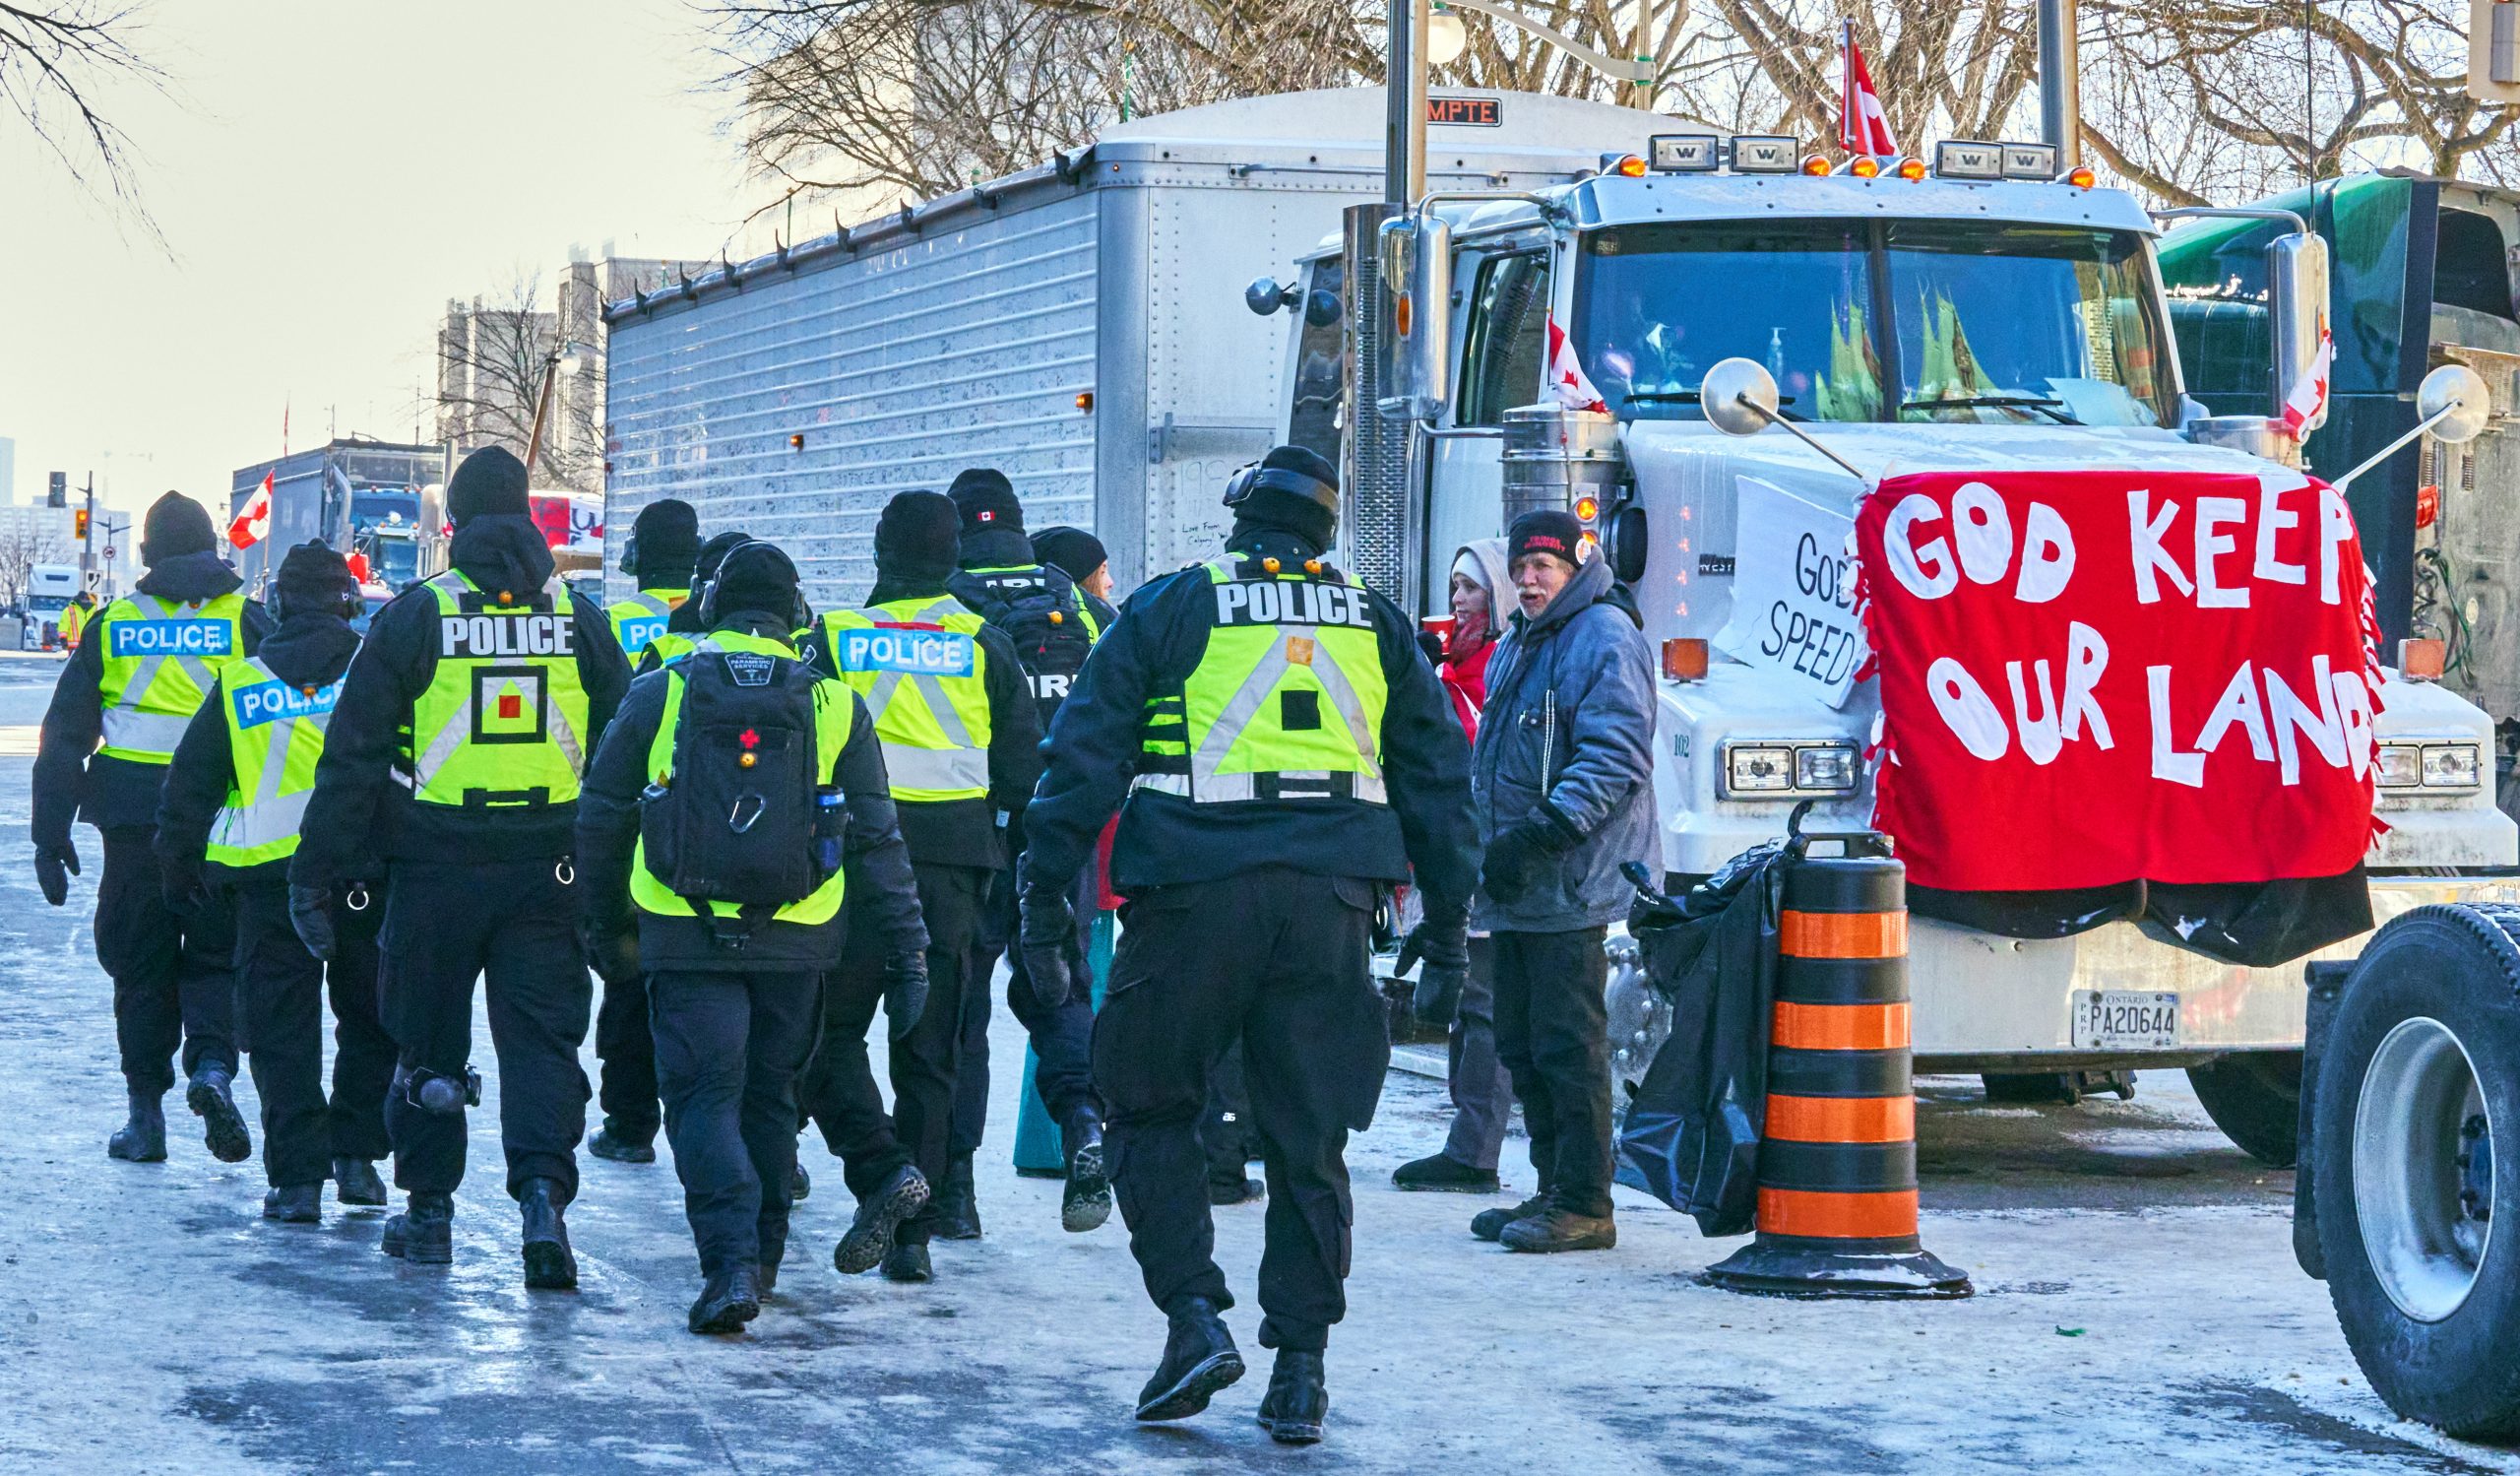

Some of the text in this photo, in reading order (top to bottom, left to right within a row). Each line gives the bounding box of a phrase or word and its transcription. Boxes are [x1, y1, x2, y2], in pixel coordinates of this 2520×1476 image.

[1427, 100, 1494, 123] MPTE
[1884, 475, 2354, 608] GOD KEEP
[1216, 582, 1372, 627] POLICE
[119, 625, 221, 649] POLICE
[442, 615, 574, 656] POLICE
[850, 636, 963, 668] POLICE
[1761, 600, 1856, 686] SPEED
[1926, 621, 2373, 788] OUR LAND
[1673, 734, 1689, 757] 102
[2090, 1005, 2174, 1035] PA20644
